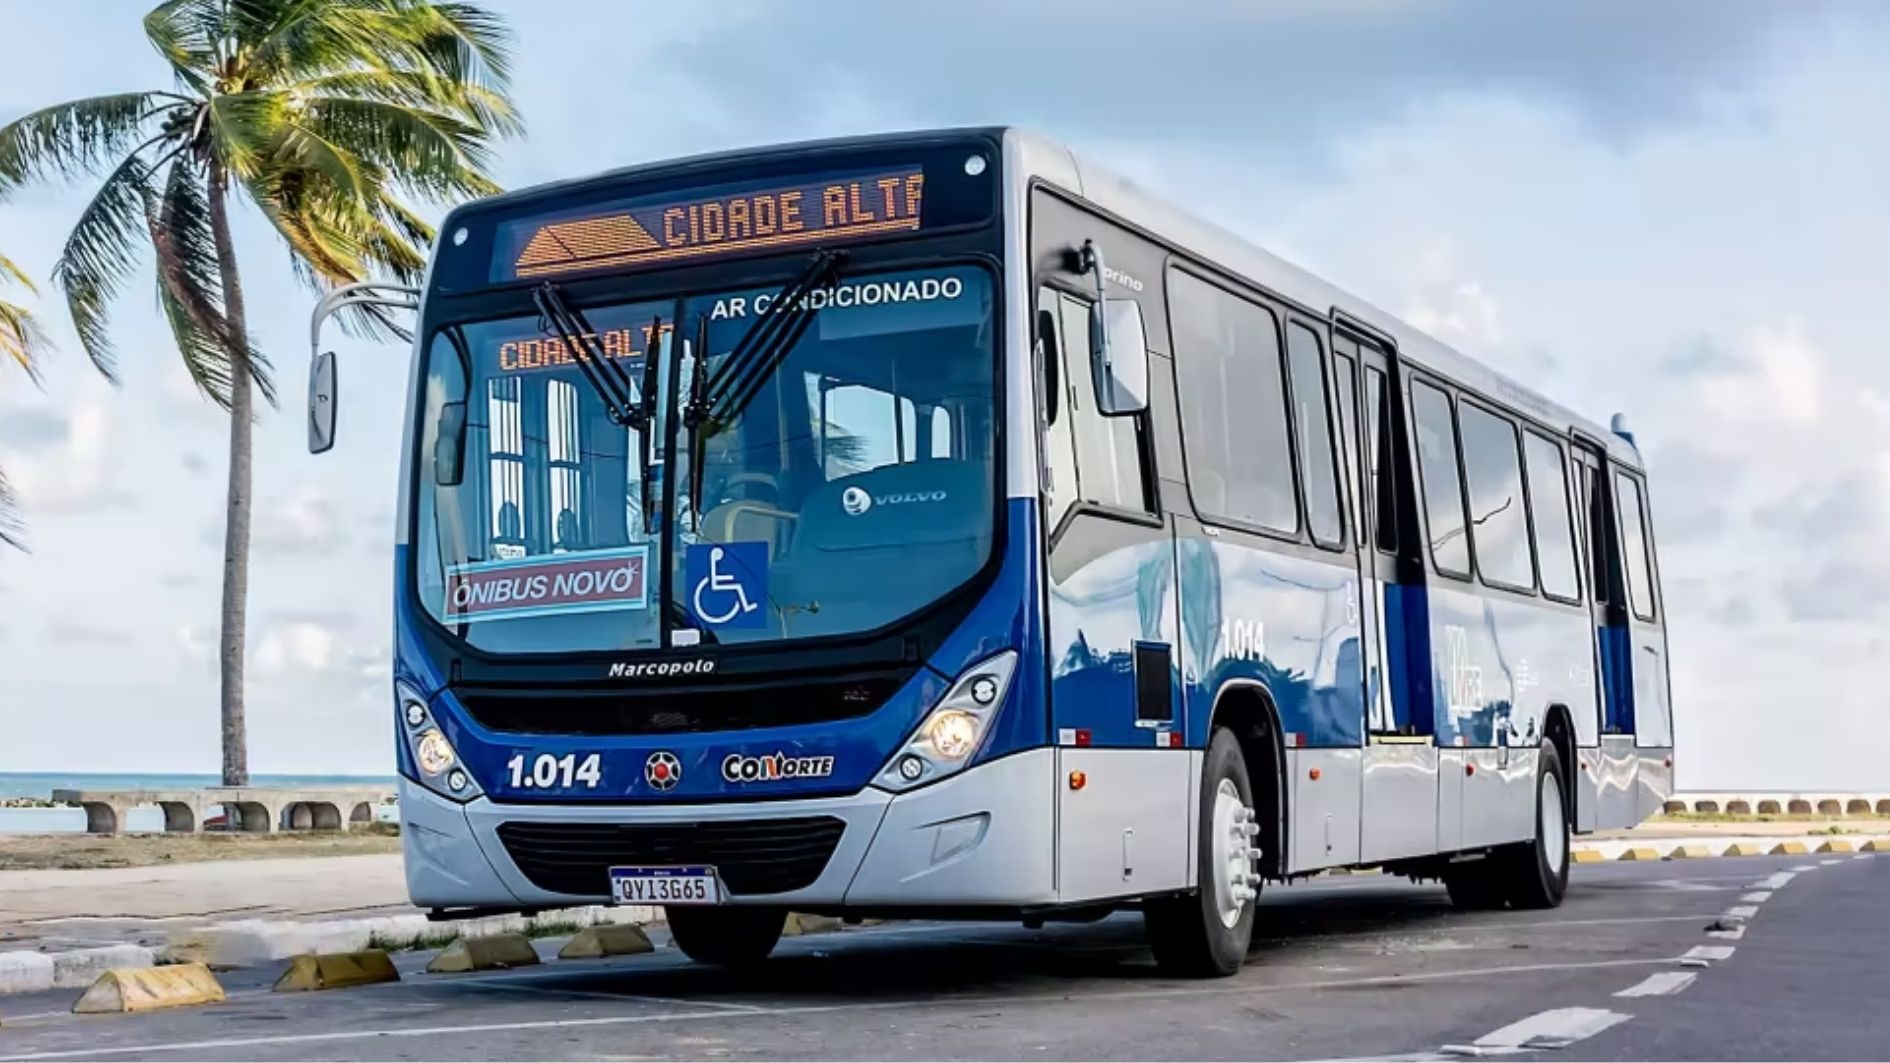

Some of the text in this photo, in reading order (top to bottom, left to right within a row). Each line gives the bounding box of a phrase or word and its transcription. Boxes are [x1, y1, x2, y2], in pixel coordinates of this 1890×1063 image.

[664, 191, 804, 248] CIDADE
[1102, 265, 1144, 292] orino
[710, 297, 746, 320] AR
[875, 489, 947, 506] VOLVO
[453, 566, 634, 608] ÔNIBUS NOVO
[1220, 617, 1266, 663] 1.014
[608, 658, 715, 678] Marcopolo
[507, 753, 601, 789] 1.014
